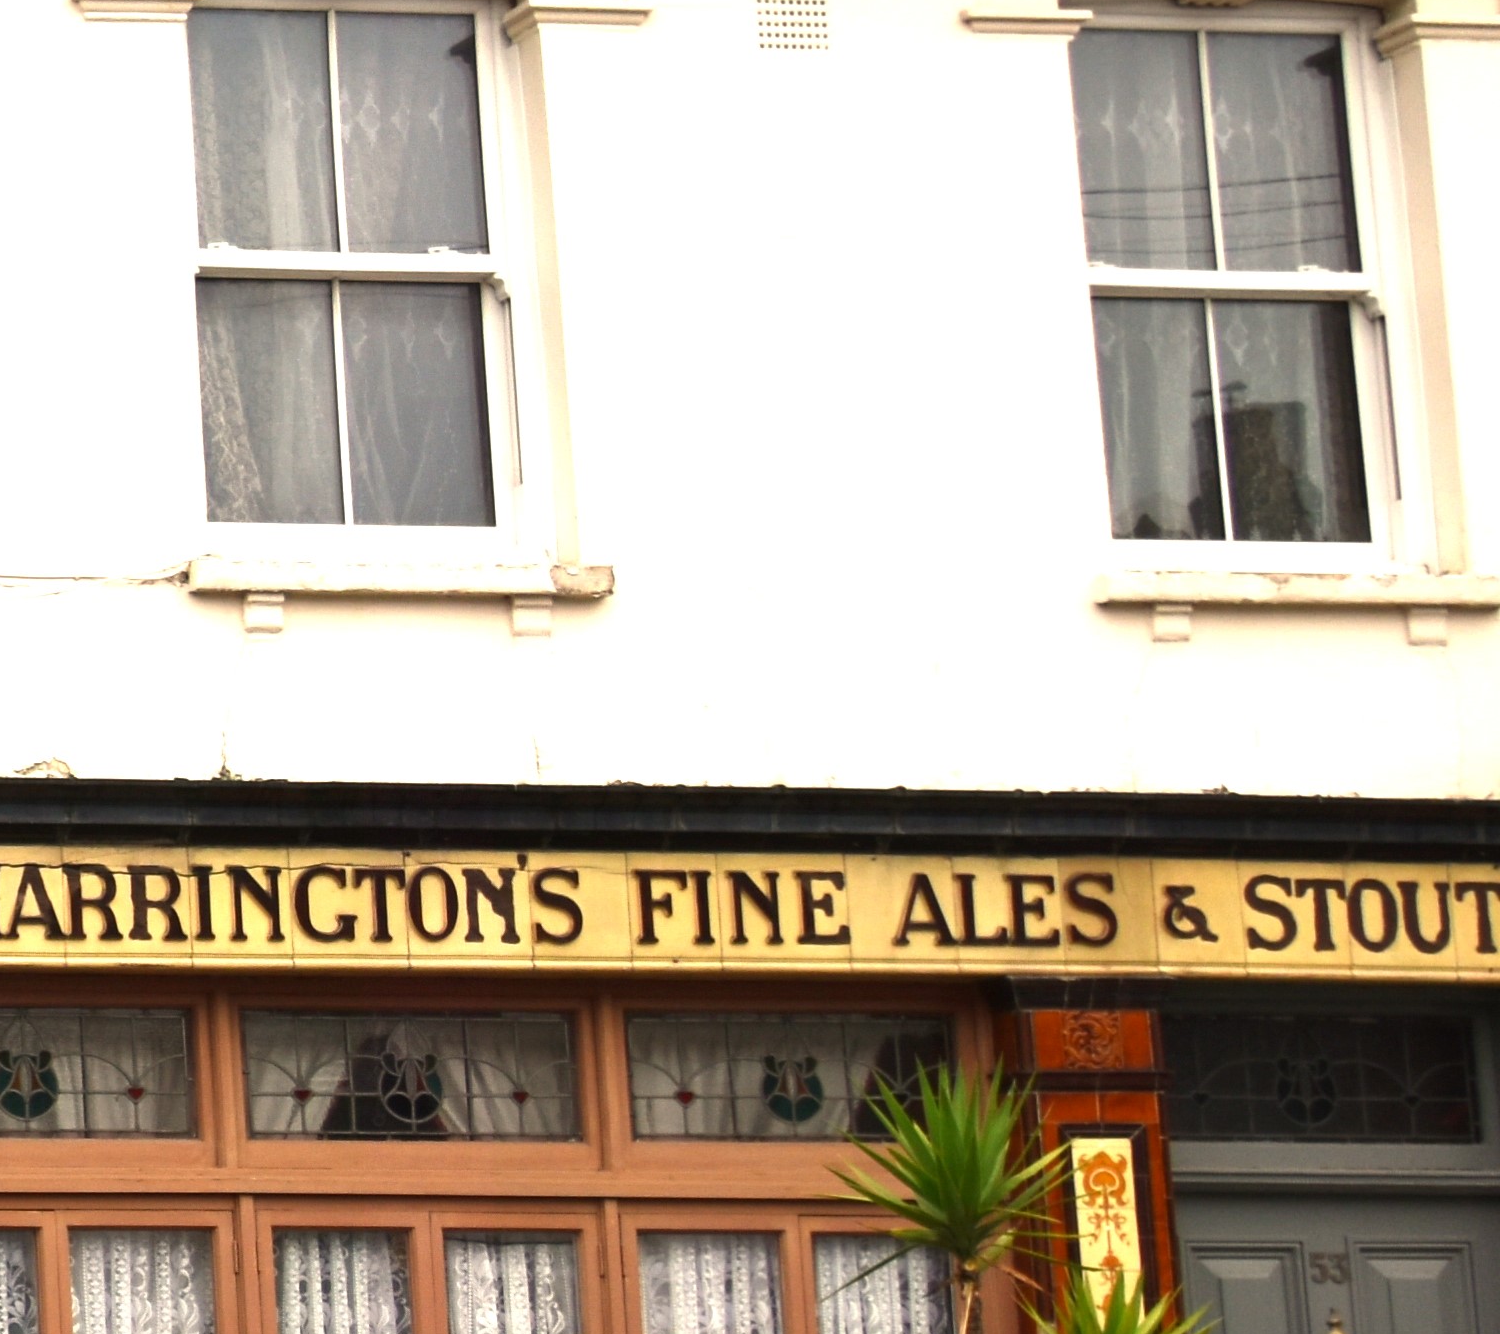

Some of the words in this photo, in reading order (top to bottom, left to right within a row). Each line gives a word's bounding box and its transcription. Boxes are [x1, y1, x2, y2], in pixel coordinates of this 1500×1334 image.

[631, 869, 852, 947] FINE
[892, 871, 1120, 949] ALES
[1163, 883, 1219, 943] &
[1309, 1252, 1352, 1285] 53
